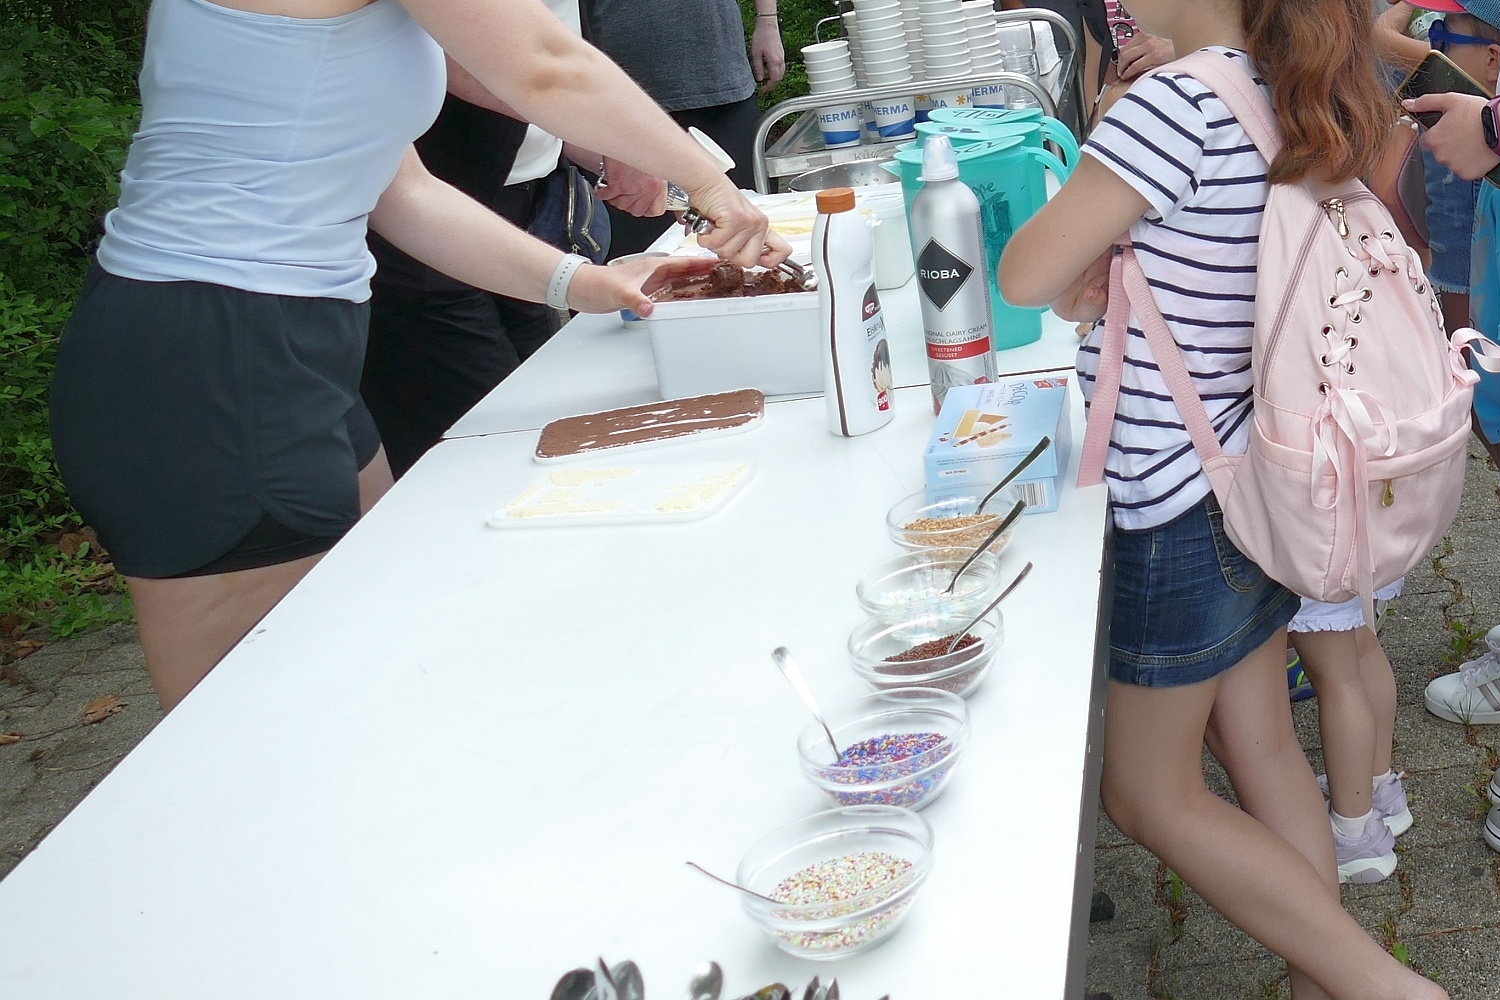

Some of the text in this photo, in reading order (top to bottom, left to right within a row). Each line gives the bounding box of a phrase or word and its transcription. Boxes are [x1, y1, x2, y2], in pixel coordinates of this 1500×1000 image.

[819, 109, 857, 123] HERMA
[919, 268, 961, 280] RIOBA
[945, 329, 966, 337] DAIRY
[967, 323, 987, 334] CREAM
